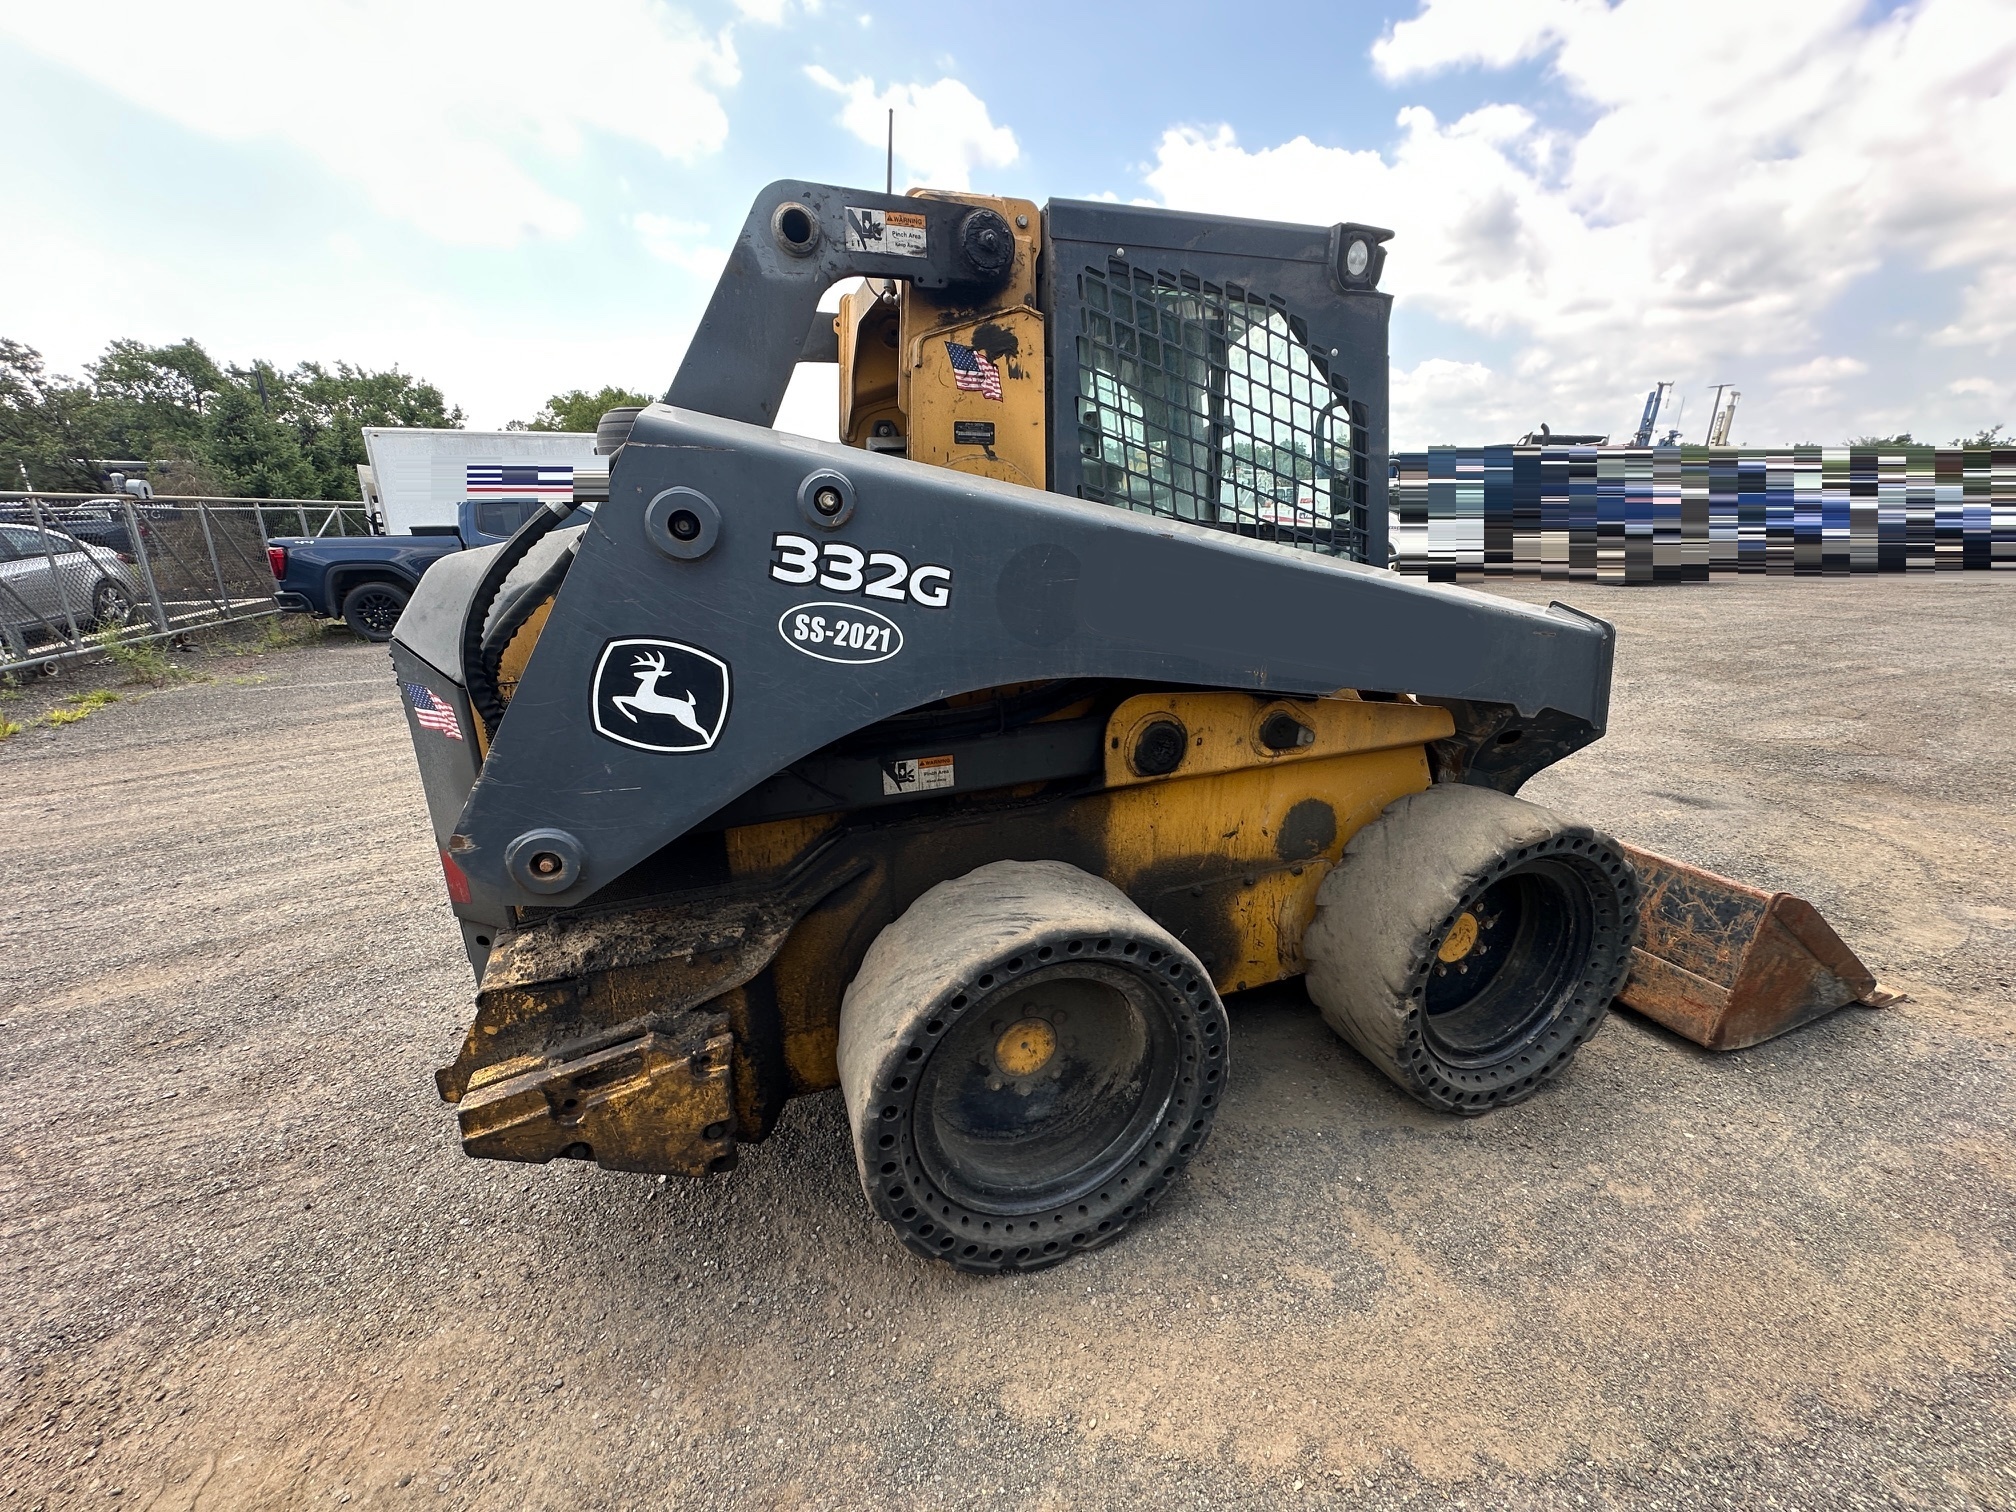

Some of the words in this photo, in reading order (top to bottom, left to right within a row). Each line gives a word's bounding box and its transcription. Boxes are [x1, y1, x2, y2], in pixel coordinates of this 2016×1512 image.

[893, 215, 922, 225] WARNING
[892, 230, 907, 238] Pinch
[770, 533, 952, 608] 332G
[793, 613, 892, 653] SS-2021
